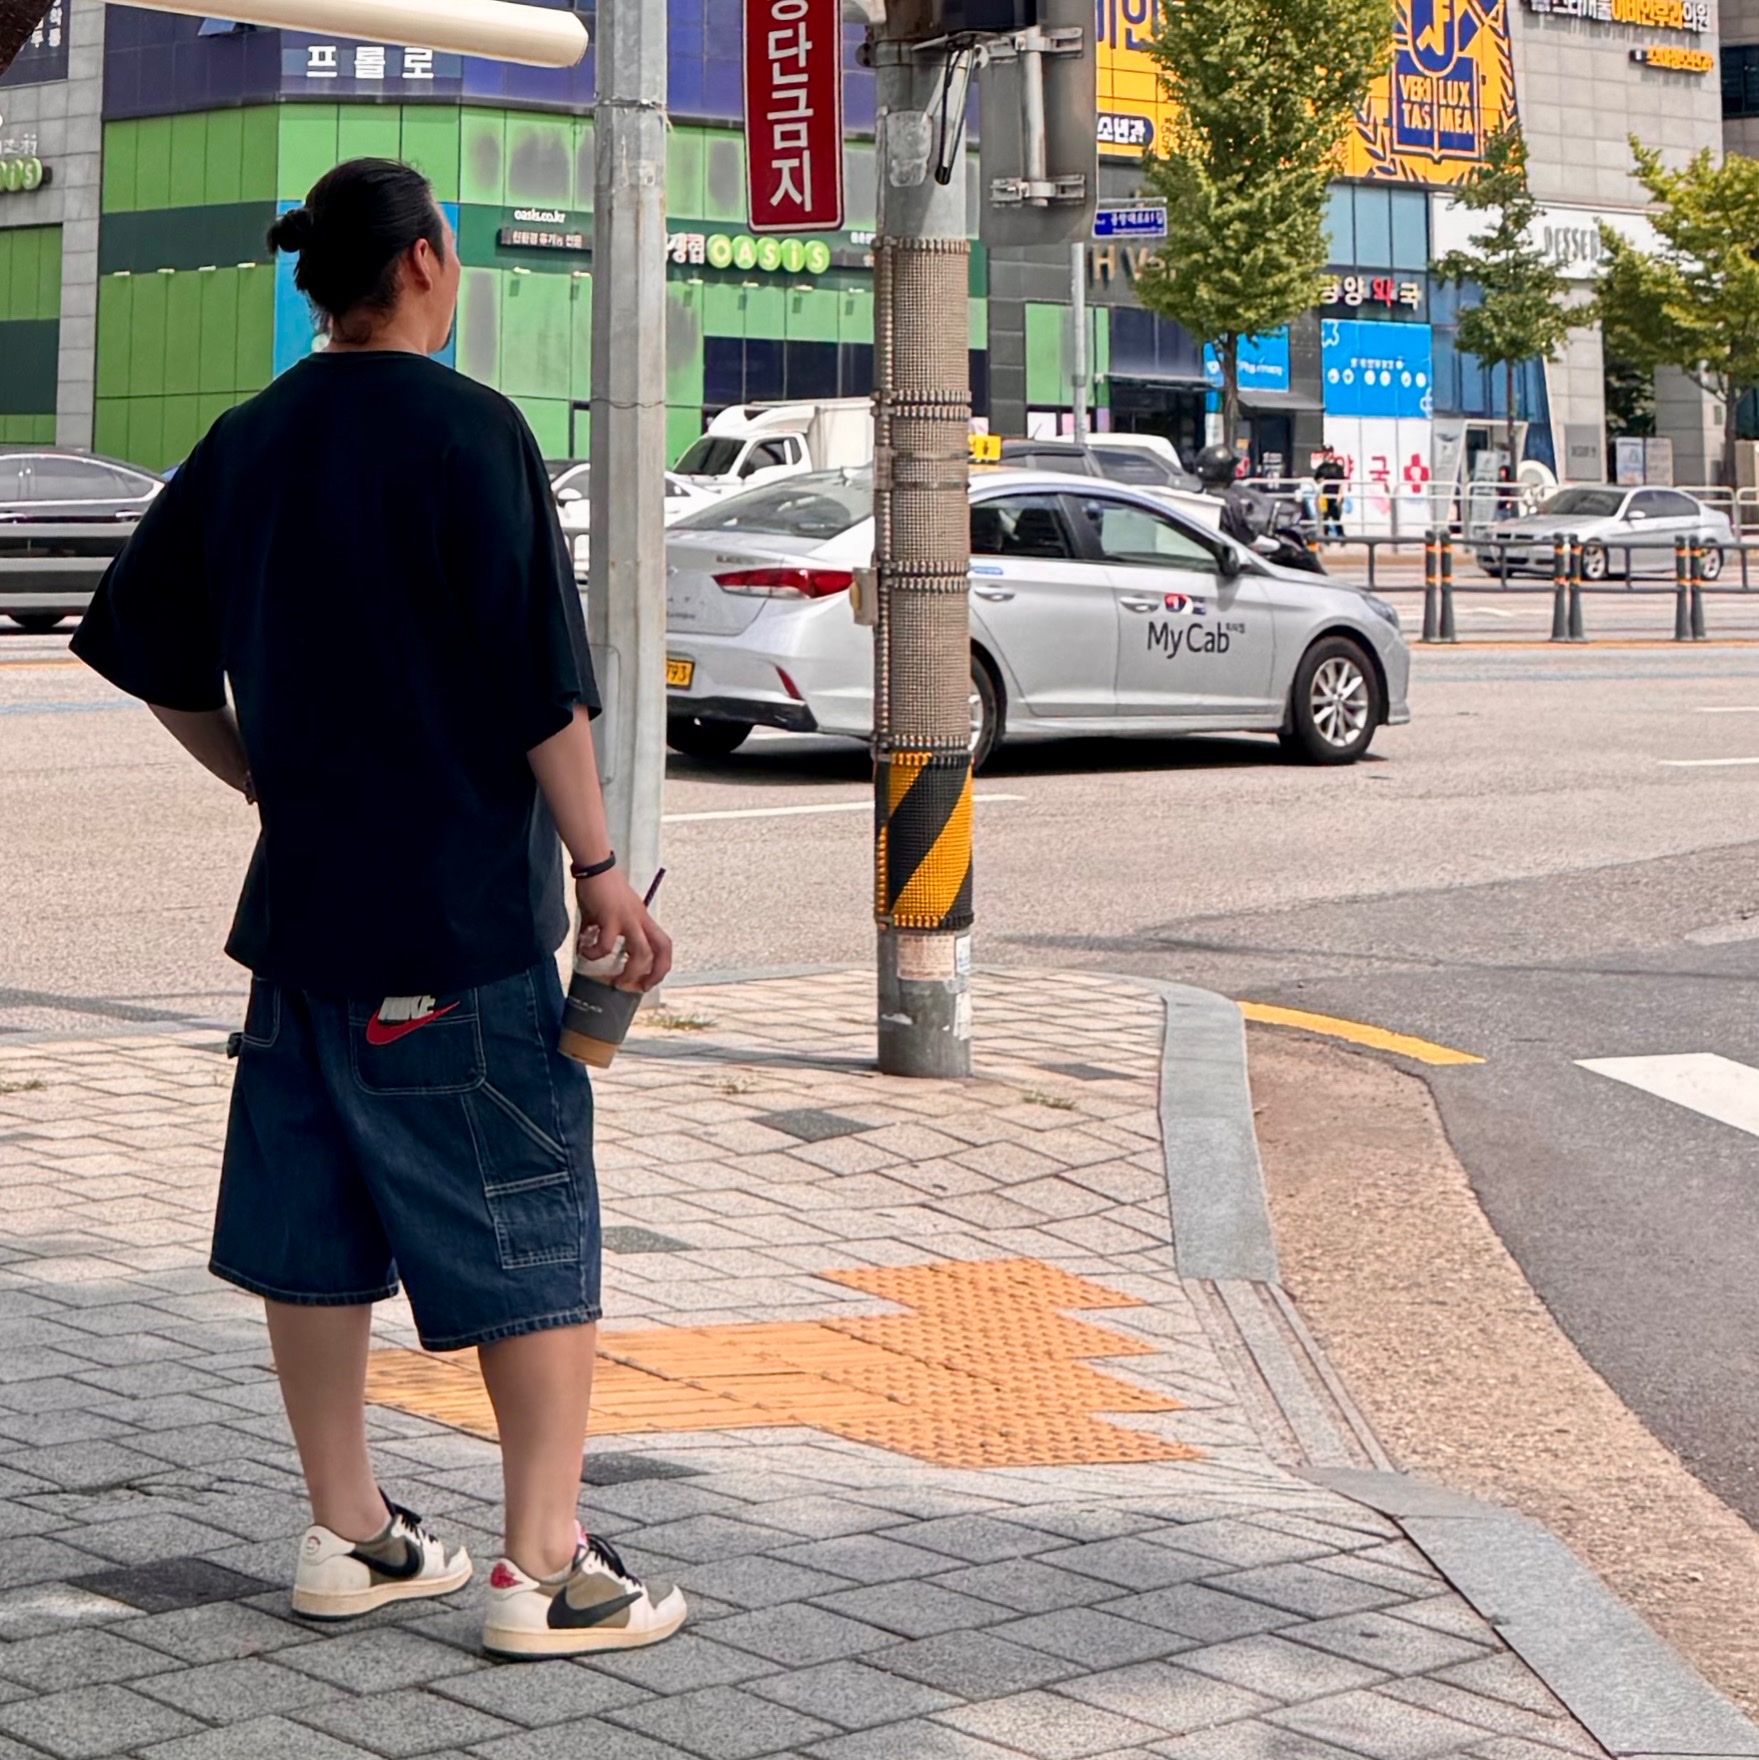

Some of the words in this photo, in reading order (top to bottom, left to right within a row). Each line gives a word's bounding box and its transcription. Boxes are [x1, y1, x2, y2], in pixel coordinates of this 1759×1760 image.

[1438, 79, 1470, 107] LUX
[1401, 102, 1431, 130] TAS
[1439, 106, 1473, 135] MEA
[377, 994, 436, 1021] NIKE
